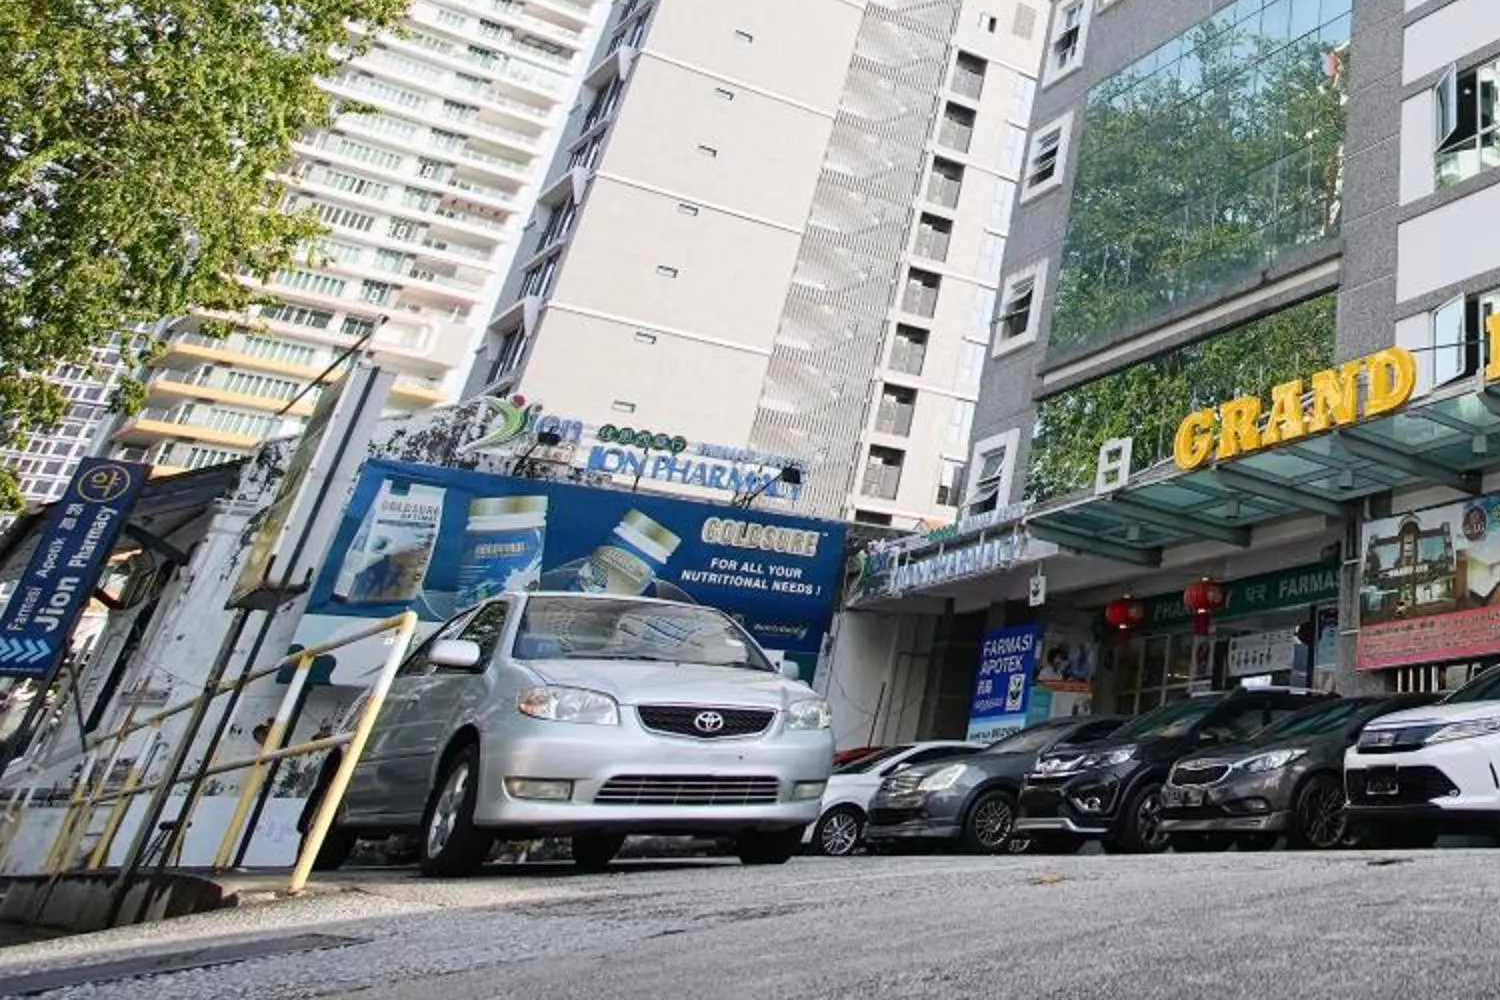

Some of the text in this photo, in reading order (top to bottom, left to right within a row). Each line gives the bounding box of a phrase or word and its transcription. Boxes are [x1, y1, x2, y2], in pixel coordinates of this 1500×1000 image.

[1173, 345, 1418, 471] GRAND
[652, 455, 801, 498] PHARMA
[702, 517, 820, 557] GOLDSURE
[33, 575, 81, 633] Jion
[67, 505, 119, 568] Pharmacy
[681, 569, 769, 590] NUTRITIONAL
[771, 581, 813, 595] NEEDS
[710, 557, 803, 579] FOR ALL YOUR
[1279, 570, 1341, 599] FARMAS
[983, 633, 1033, 657] FARMASI
[979, 654, 1024, 677] APOTEK
